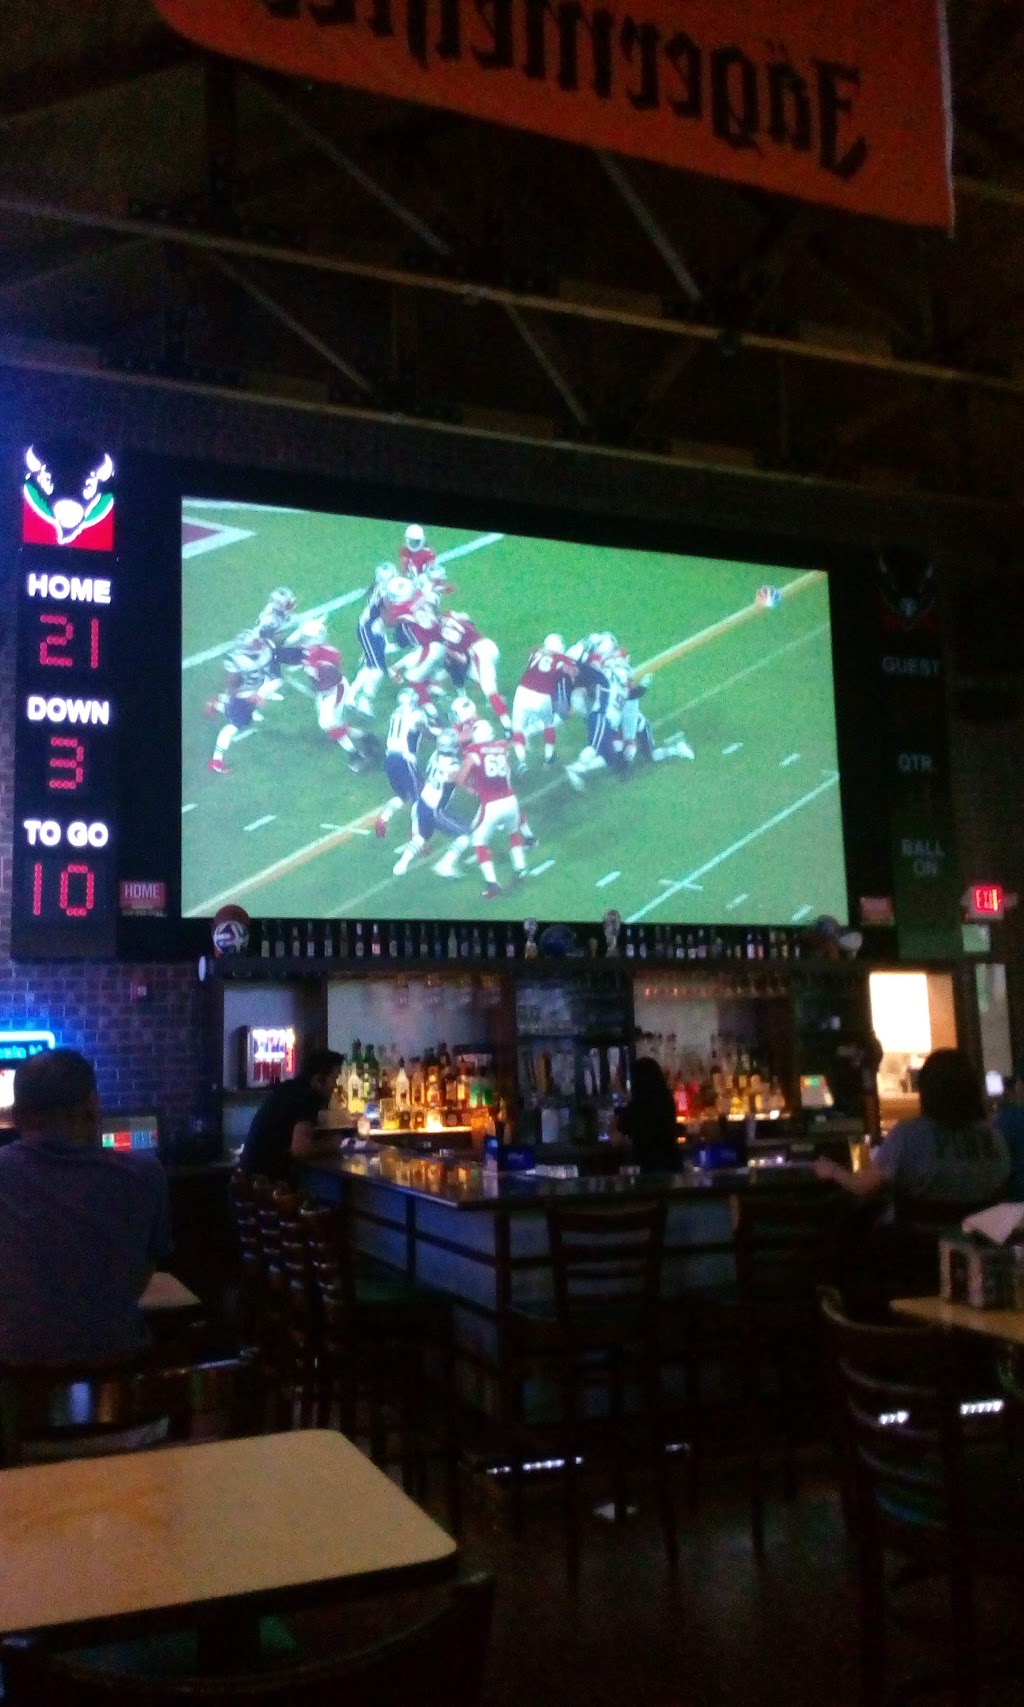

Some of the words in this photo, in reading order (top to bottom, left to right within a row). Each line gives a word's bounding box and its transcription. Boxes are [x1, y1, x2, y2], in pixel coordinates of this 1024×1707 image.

[27, 573, 112, 604] HOME
[38, 614, 100, 669] 21
[881, 656, 940, 674] GUEST
[26, 696, 110, 725] DOWN
[49, 736, 85, 789] 3
[24, 820, 61, 848] TO
[67, 822, 109, 848] GO
[33, 864, 94, 917] 10
[124, 883, 161, 899] HOME
